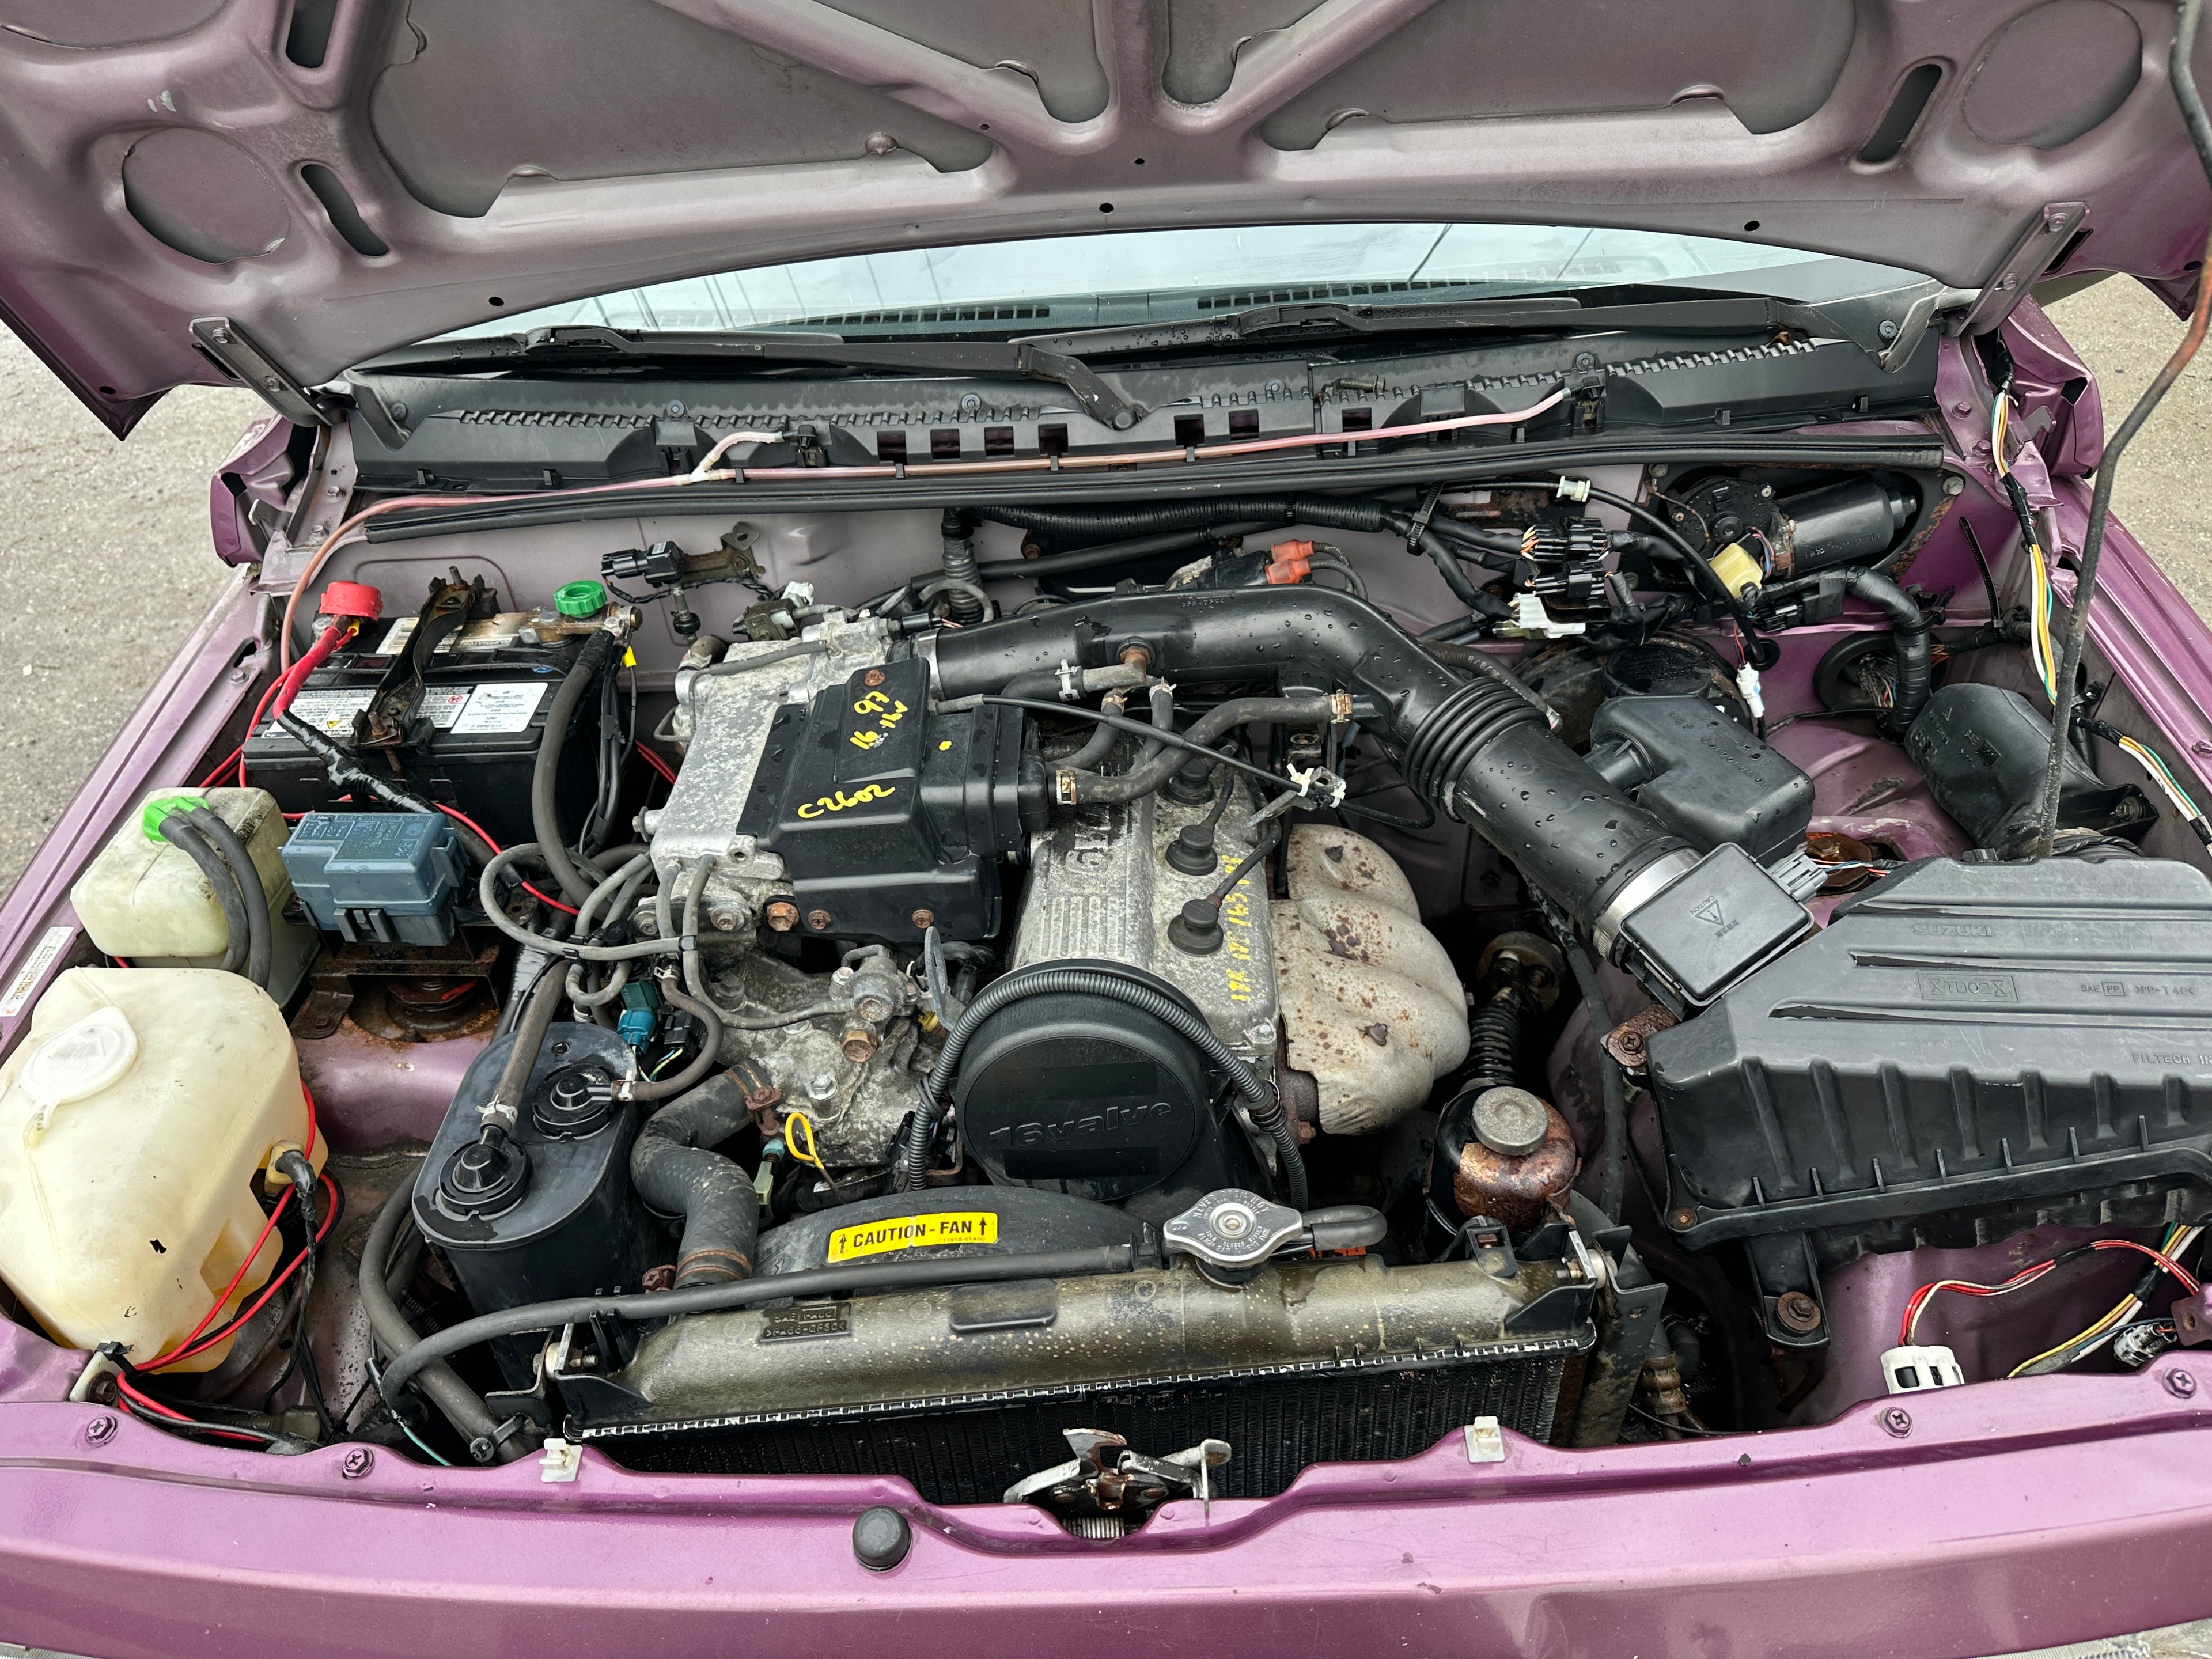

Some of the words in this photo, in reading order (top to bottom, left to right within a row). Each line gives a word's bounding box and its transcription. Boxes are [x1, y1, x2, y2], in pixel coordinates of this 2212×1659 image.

[1467, 656, 1500, 679] 8/8/96
[854, 691, 890, 714] 97
[850, 730, 878, 750] 1.6
[1701, 736, 1769, 790] Corporation
[797, 783, 896, 819] C2602
[1689, 895, 1714, 915] CAUTION
[1913, 924, 1993, 937] SUZUKI
[2081, 984, 2102, 993] SAE
[2106, 985, 2120, 993] PP
[2131, 1052, 2191, 1065] FILTECH
[988, 1101, 1172, 1150] 16valve
[1192, 1194, 1217, 1219] NEVER
[1220, 1190, 1248, 1199] OPEN
[1250, 1196, 1270, 1213] HOT
[1243, 1200, 1261, 1215] BOTTLE
[853, 1222, 926, 1248] CAUTION
[940, 1220, 973, 1235] FAN
[1198, 1233, 1215, 1247] ALIGN
[1257, 1227, 1271, 1241] TUBE
